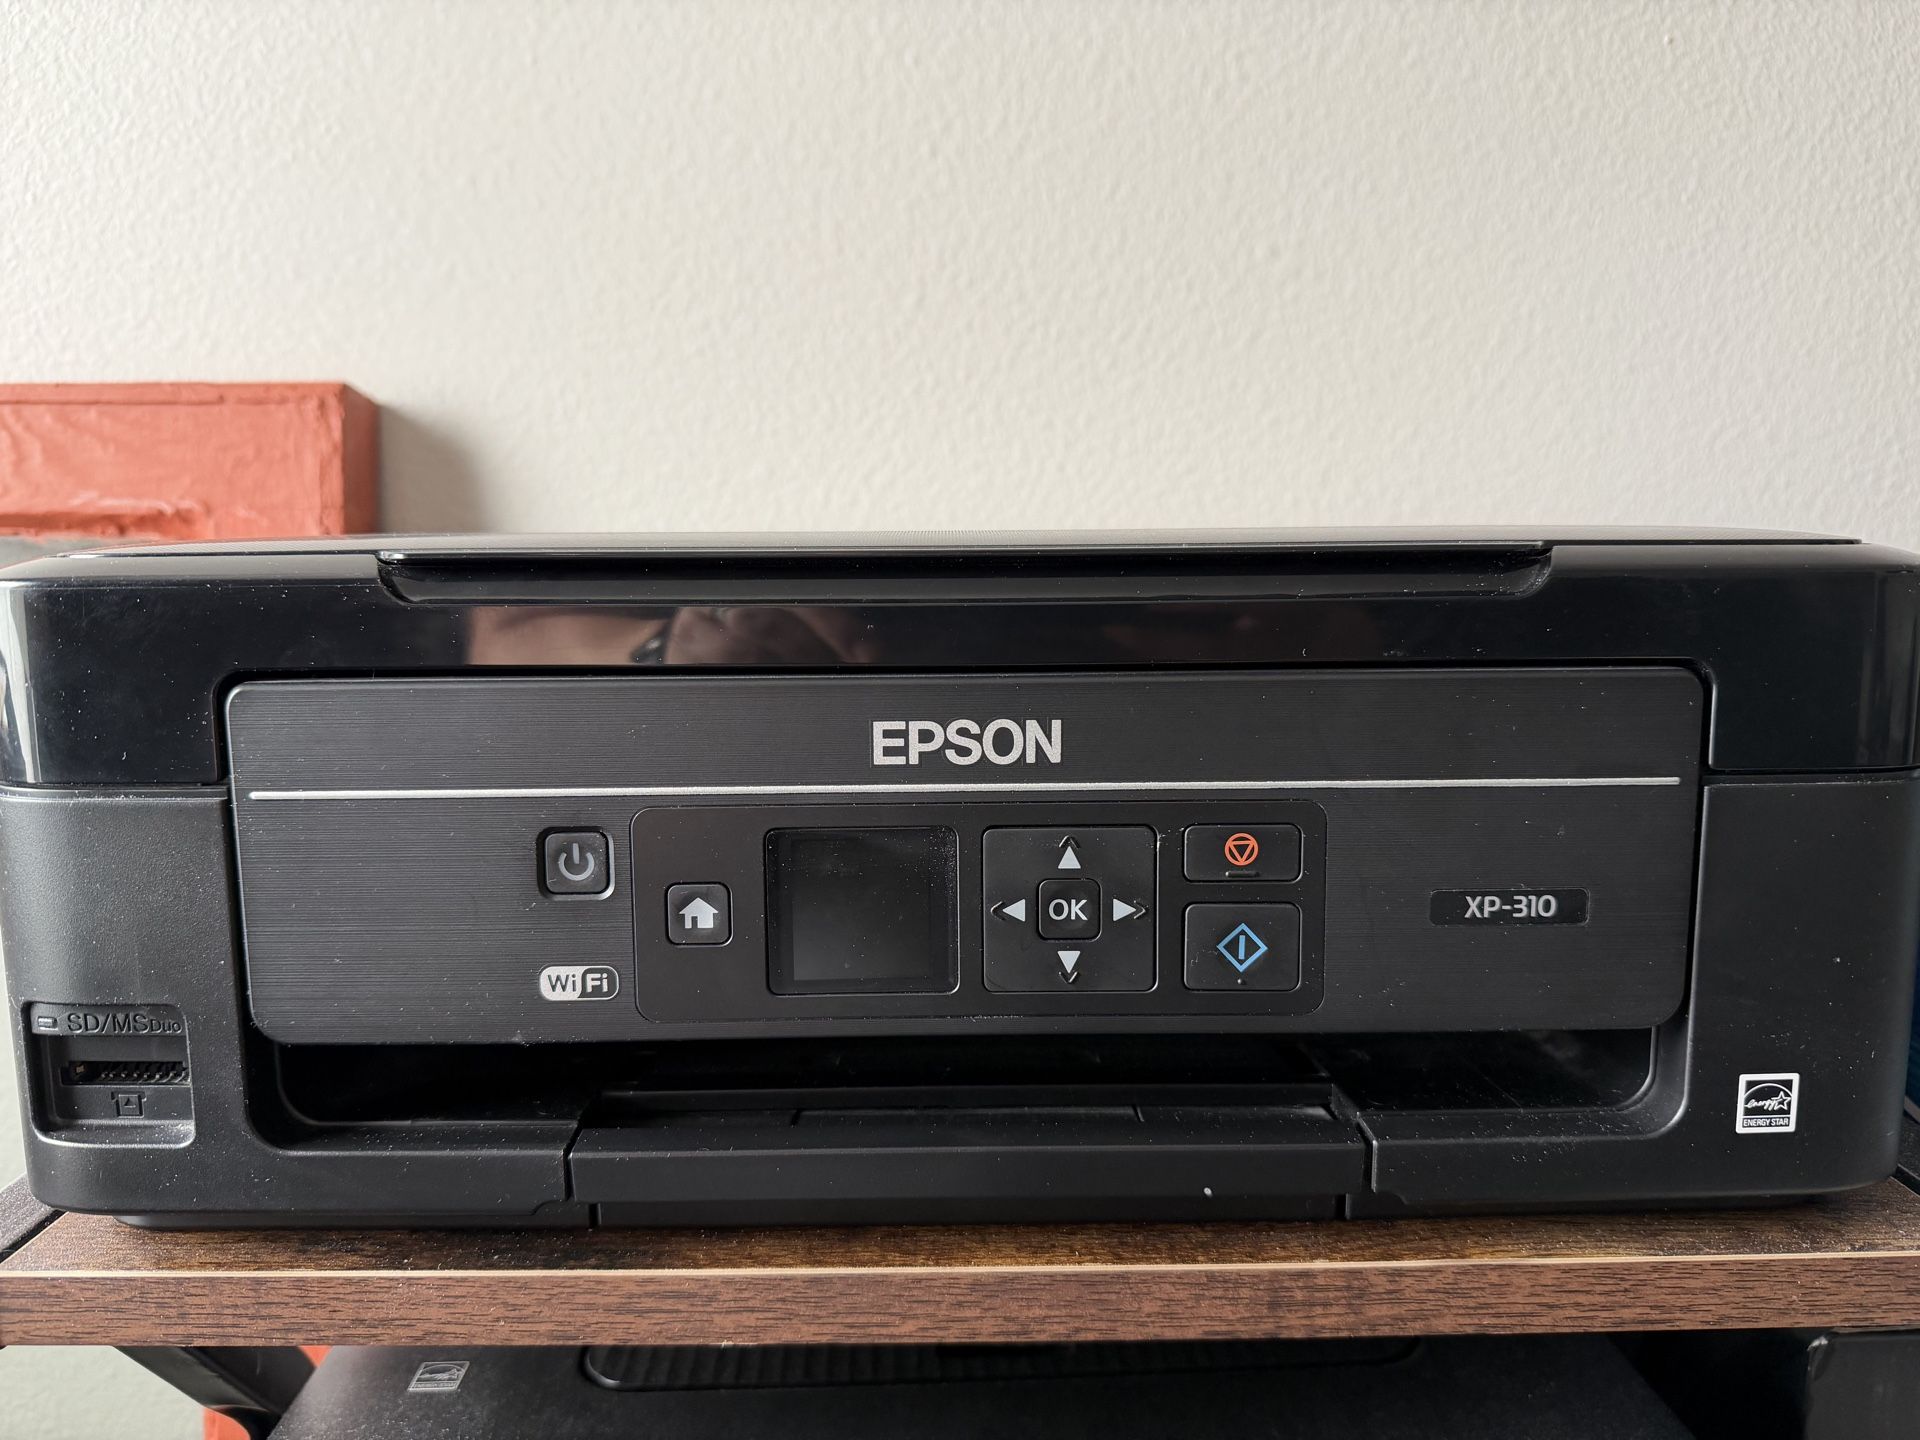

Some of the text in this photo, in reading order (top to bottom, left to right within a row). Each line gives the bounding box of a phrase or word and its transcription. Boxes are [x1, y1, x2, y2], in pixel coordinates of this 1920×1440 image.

[872, 719, 1062, 765] EPSON
[1048, 899, 1088, 920] OK
[1464, 895, 1557, 918] XP-310
[1743, 1118, 1789, 1127] ENERGY STAR
